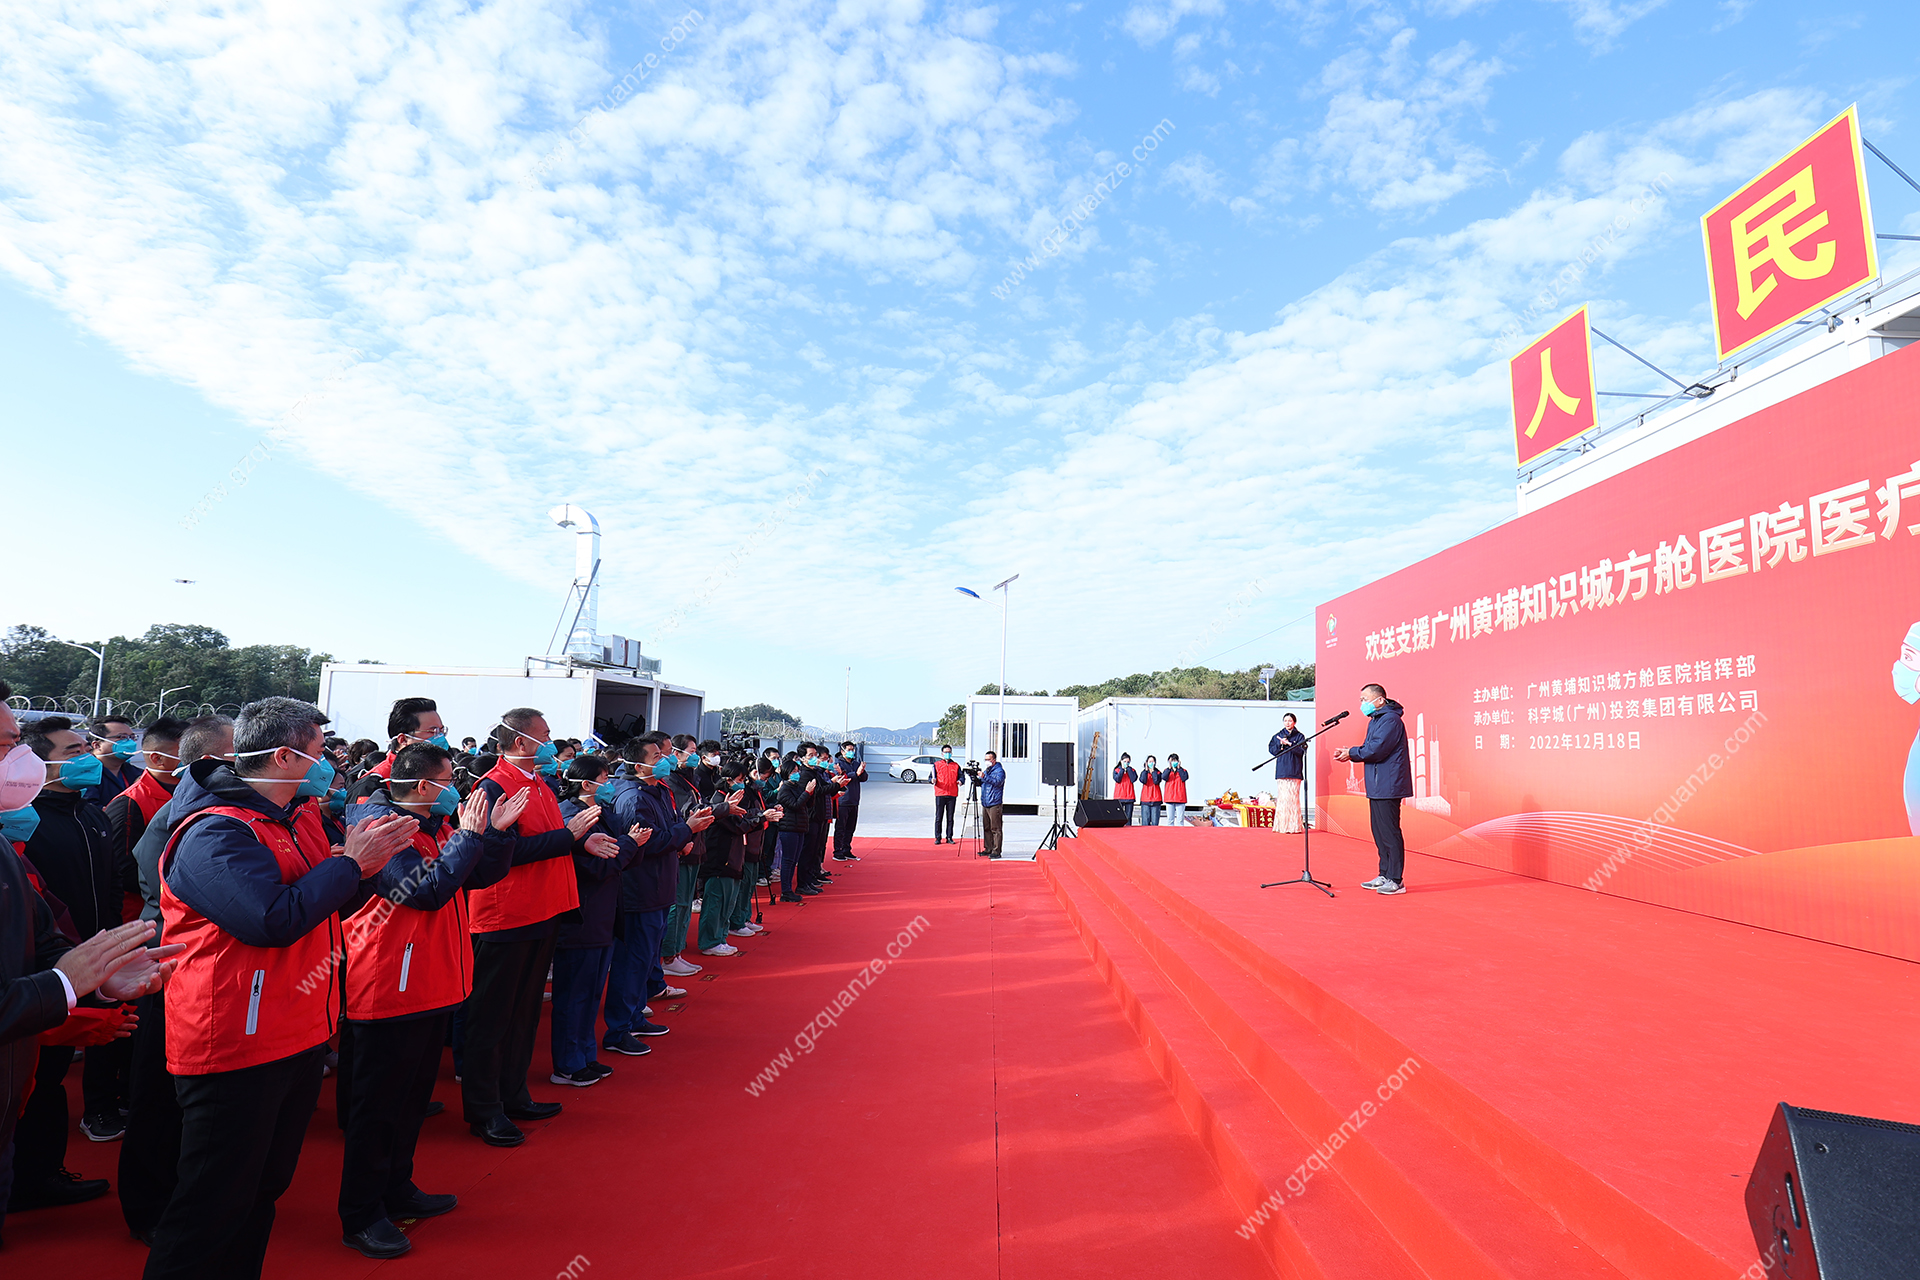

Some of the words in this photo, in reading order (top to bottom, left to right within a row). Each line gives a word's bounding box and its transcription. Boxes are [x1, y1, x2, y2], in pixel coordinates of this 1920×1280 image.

[1730, 163, 1837, 321] 民
[1523, 346, 1582, 439] 人
[1526, 654, 1757, 699] 广州黄埔知识城方舱医院指挥部
[1529, 731, 1641, 750] 2022年12月18日
